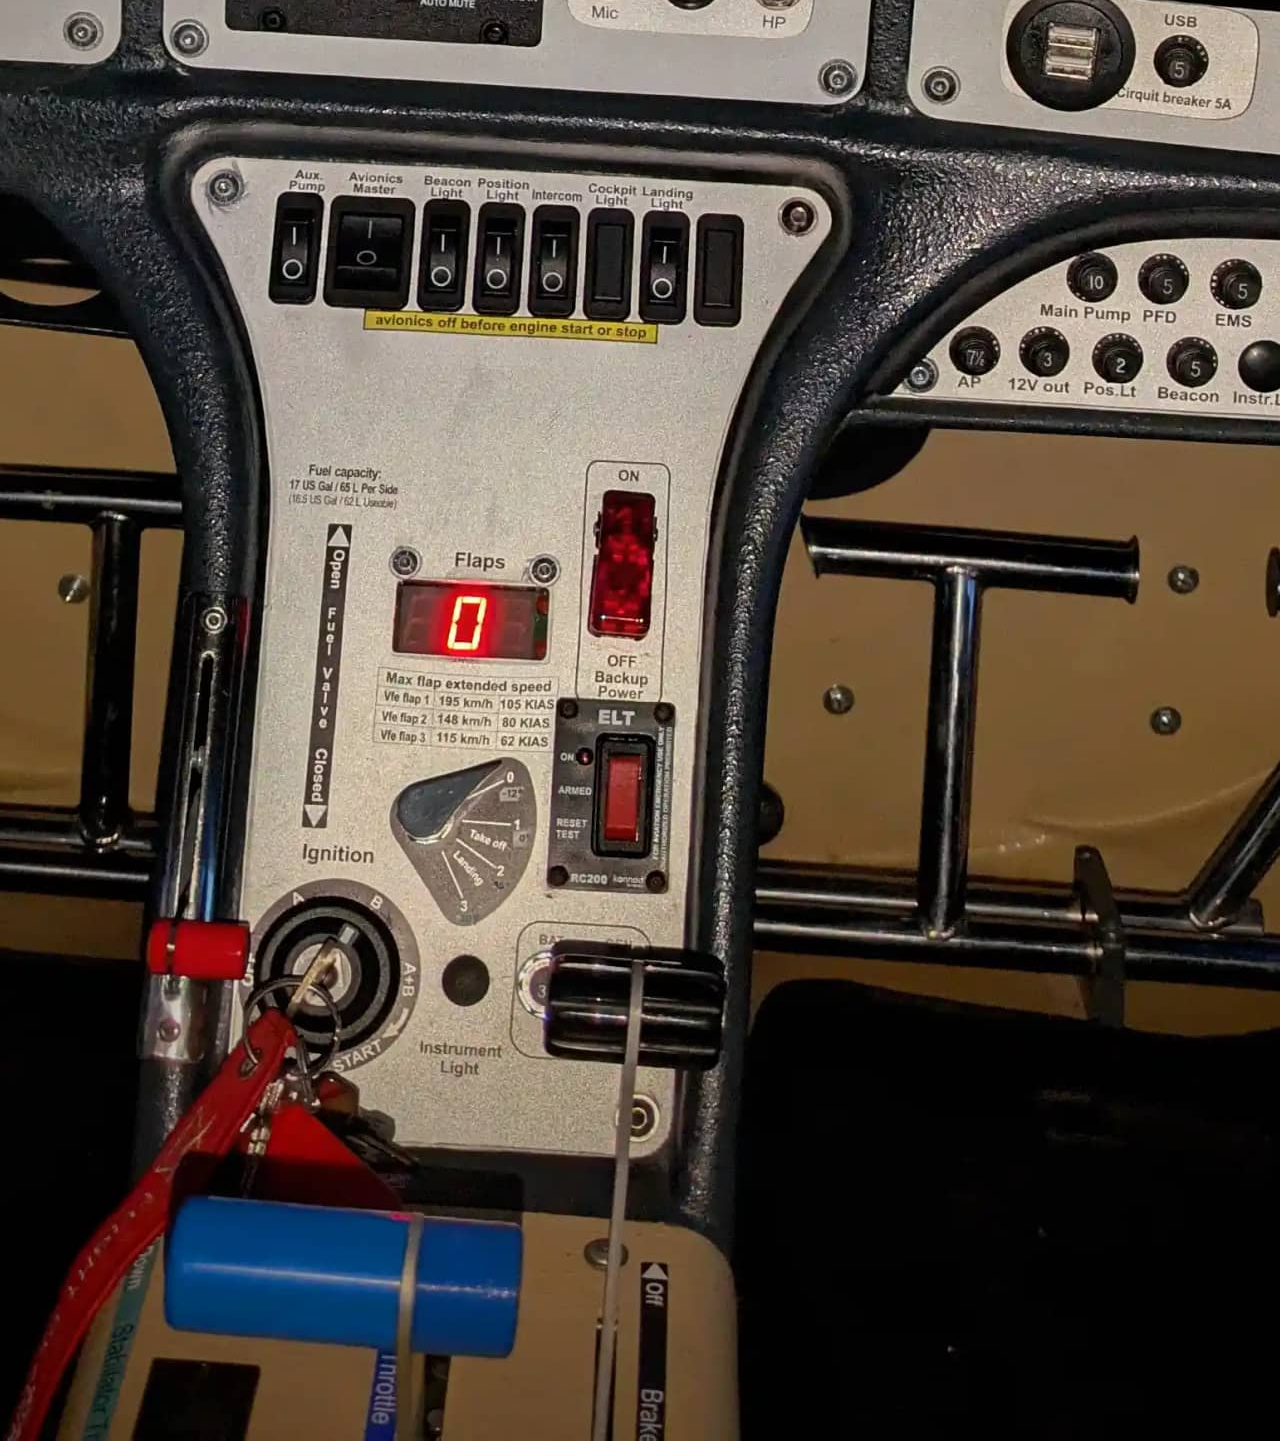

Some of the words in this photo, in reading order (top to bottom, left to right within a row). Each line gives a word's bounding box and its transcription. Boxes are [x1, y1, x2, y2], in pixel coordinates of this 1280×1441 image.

[591, 5, 617, 21] Mic
[762, 15, 786, 29] HP
[1165, 14, 1197, 28] USB
[1163, 92, 1211, 109] breaker
[1215, 97, 1231, 110] 5A
[349, 172, 403, 183] Avionics
[424, 176, 471, 187] Beacon
[478, 178, 530, 190] Position
[289, 181, 325, 192] Pump
[353, 183, 395, 194] Master
[431, 187, 462, 199] Light
[589, 183, 637, 196] Cockpit
[643, 186, 693, 201] Landing
[487, 189, 519, 202] Light
[532, 189, 582, 202] Intercom
[596, 195, 628, 207] Light
[651, 198, 683, 210] Light
[1040, 303, 1078, 318] Main
[1084, 306, 1130, 323] Pump
[1143, 310, 1176, 323] PFD
[376, 316, 433, 327] avionics
[438, 318, 457, 328] off
[461, 319, 505, 331] before
[510, 322, 556, 334] engine
[562, 324, 592, 335] start
[598, 327, 612, 335] or
[616, 327, 646, 339] stop
[1215, 314, 1252, 327] EMS
[958, 376, 981, 389] AP
[1009, 378, 1036, 390] 12V
[1044, 381, 1069, 393] out
[1084, 382, 1136, 398] Pos.Lt
[1157, 387, 1219, 402] Beacon
[309, 464, 331, 476] Fuel
[335, 467, 381, 481] capacity:
[619, 470, 639, 482] ON
[454, 552, 505, 570] Flaps
[448, 596, 486, 650] 0
[607, 655, 636, 668] OFF
[386, 672, 412, 685] Max
[417, 674, 441, 689] flap
[446, 679, 506, 691] extended
[511, 681, 551, 694] speed
[595, 672, 648, 687] Backup
[598, 686, 643, 700] Power
[598, 710, 635, 725] ELT
[558, 786, 592, 796] ARMED
[302, 844, 374, 863] Ignition
[420, 1041, 502, 1057] Instrument
[440, 1060, 479, 1075] Light
[646, 1282, 664, 1306] Off
